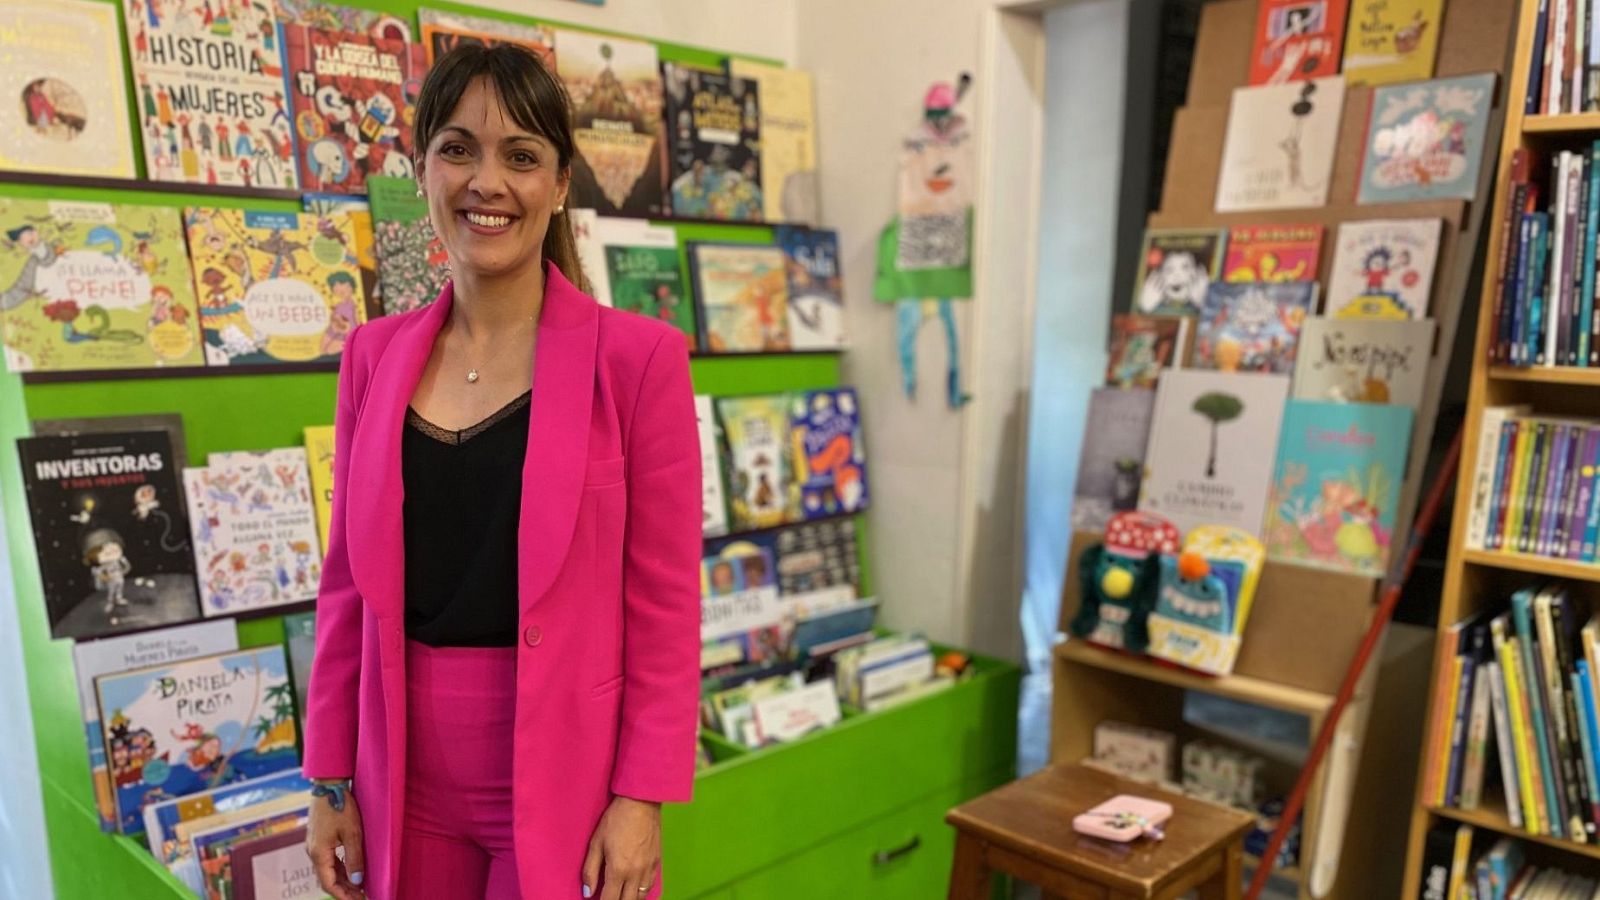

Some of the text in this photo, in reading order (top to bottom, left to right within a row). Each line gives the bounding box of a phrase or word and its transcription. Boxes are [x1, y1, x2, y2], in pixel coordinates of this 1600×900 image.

[149, 33, 264, 77] HISTORIA
[168, 84, 266, 120] MUJERES
[36, 452, 163, 481] INVENTORAS
[158, 665, 247, 701] DANIELA
[175, 691, 234, 719] PIRATA
[281, 881, 310, 899] dos
